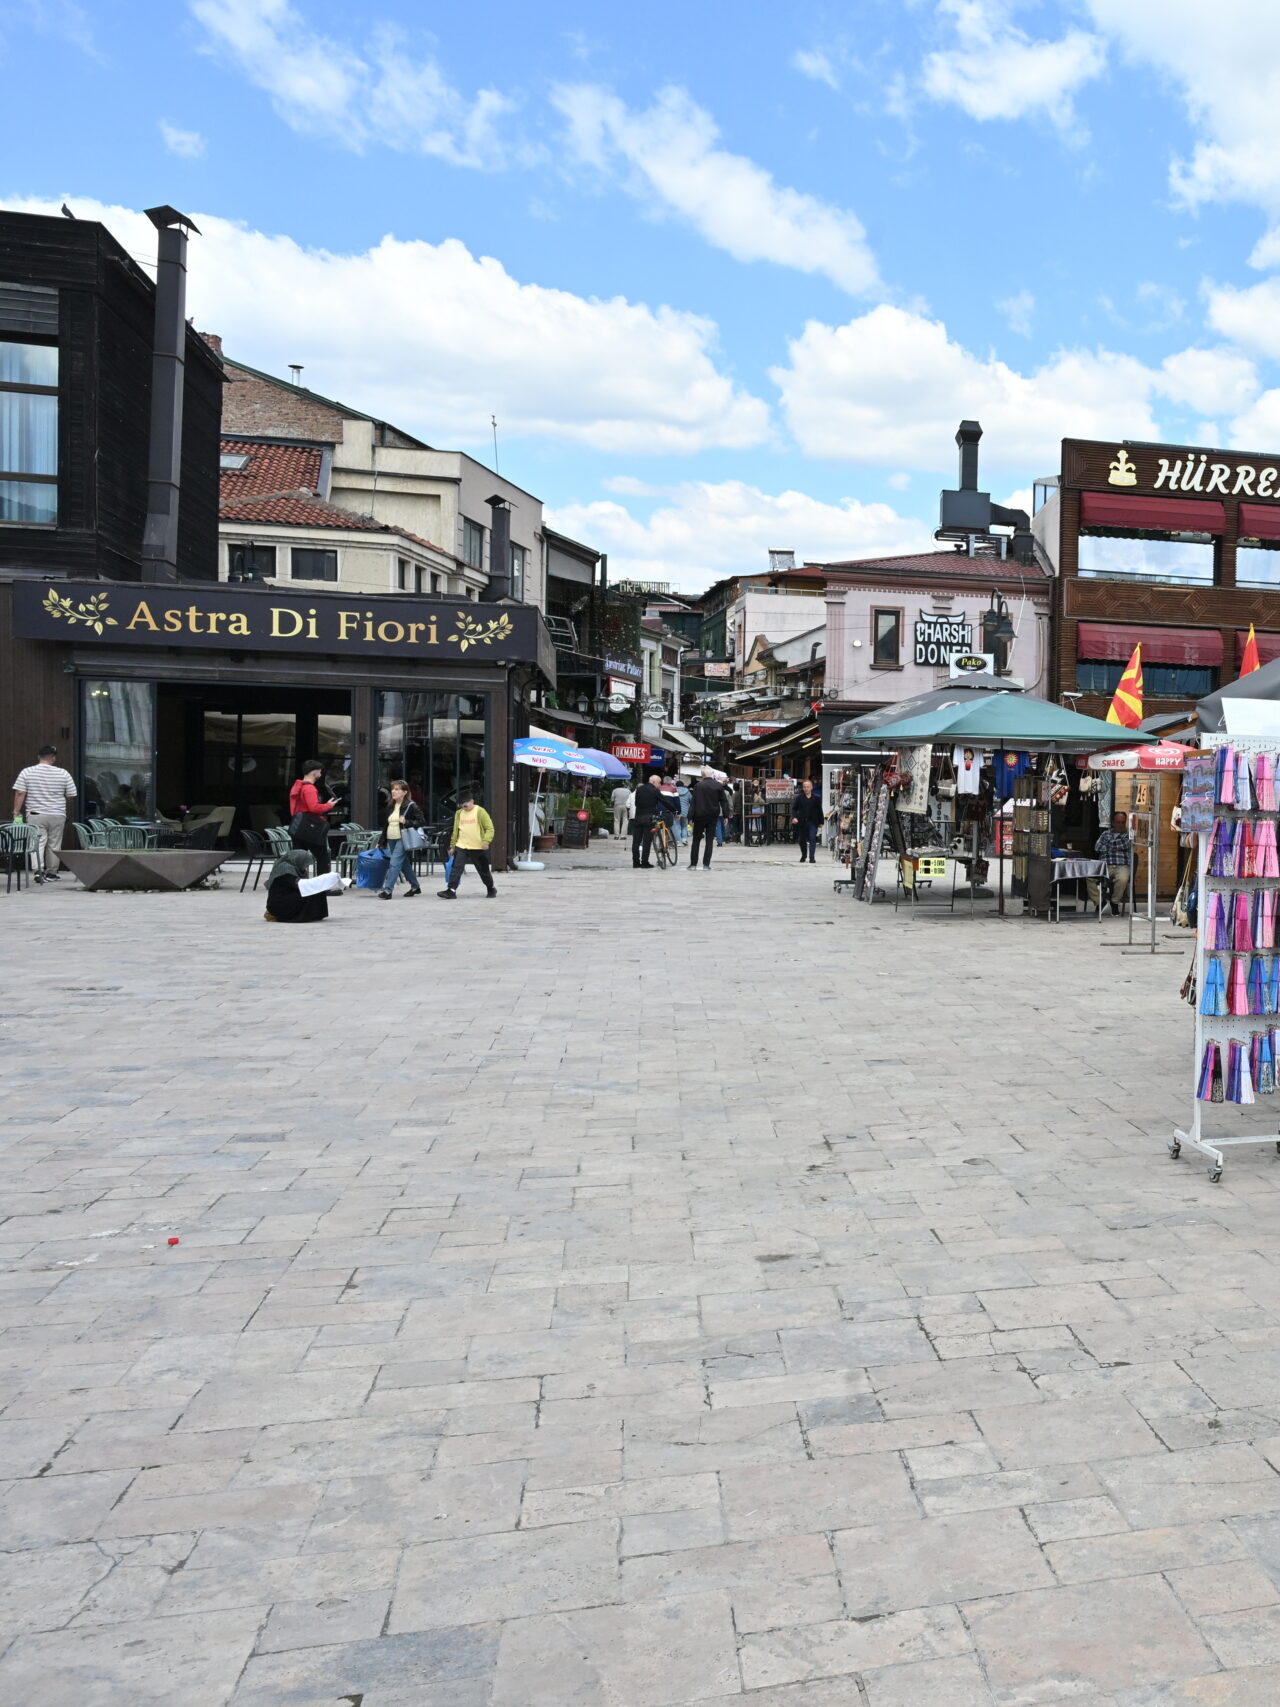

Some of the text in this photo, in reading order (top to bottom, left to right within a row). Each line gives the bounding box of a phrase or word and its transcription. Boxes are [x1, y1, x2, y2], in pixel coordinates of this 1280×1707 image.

[126, 601, 440, 645] Astra Di Fiori
[916, 622, 972, 644] CHARSHI
[961, 658, 982, 666] Pako
